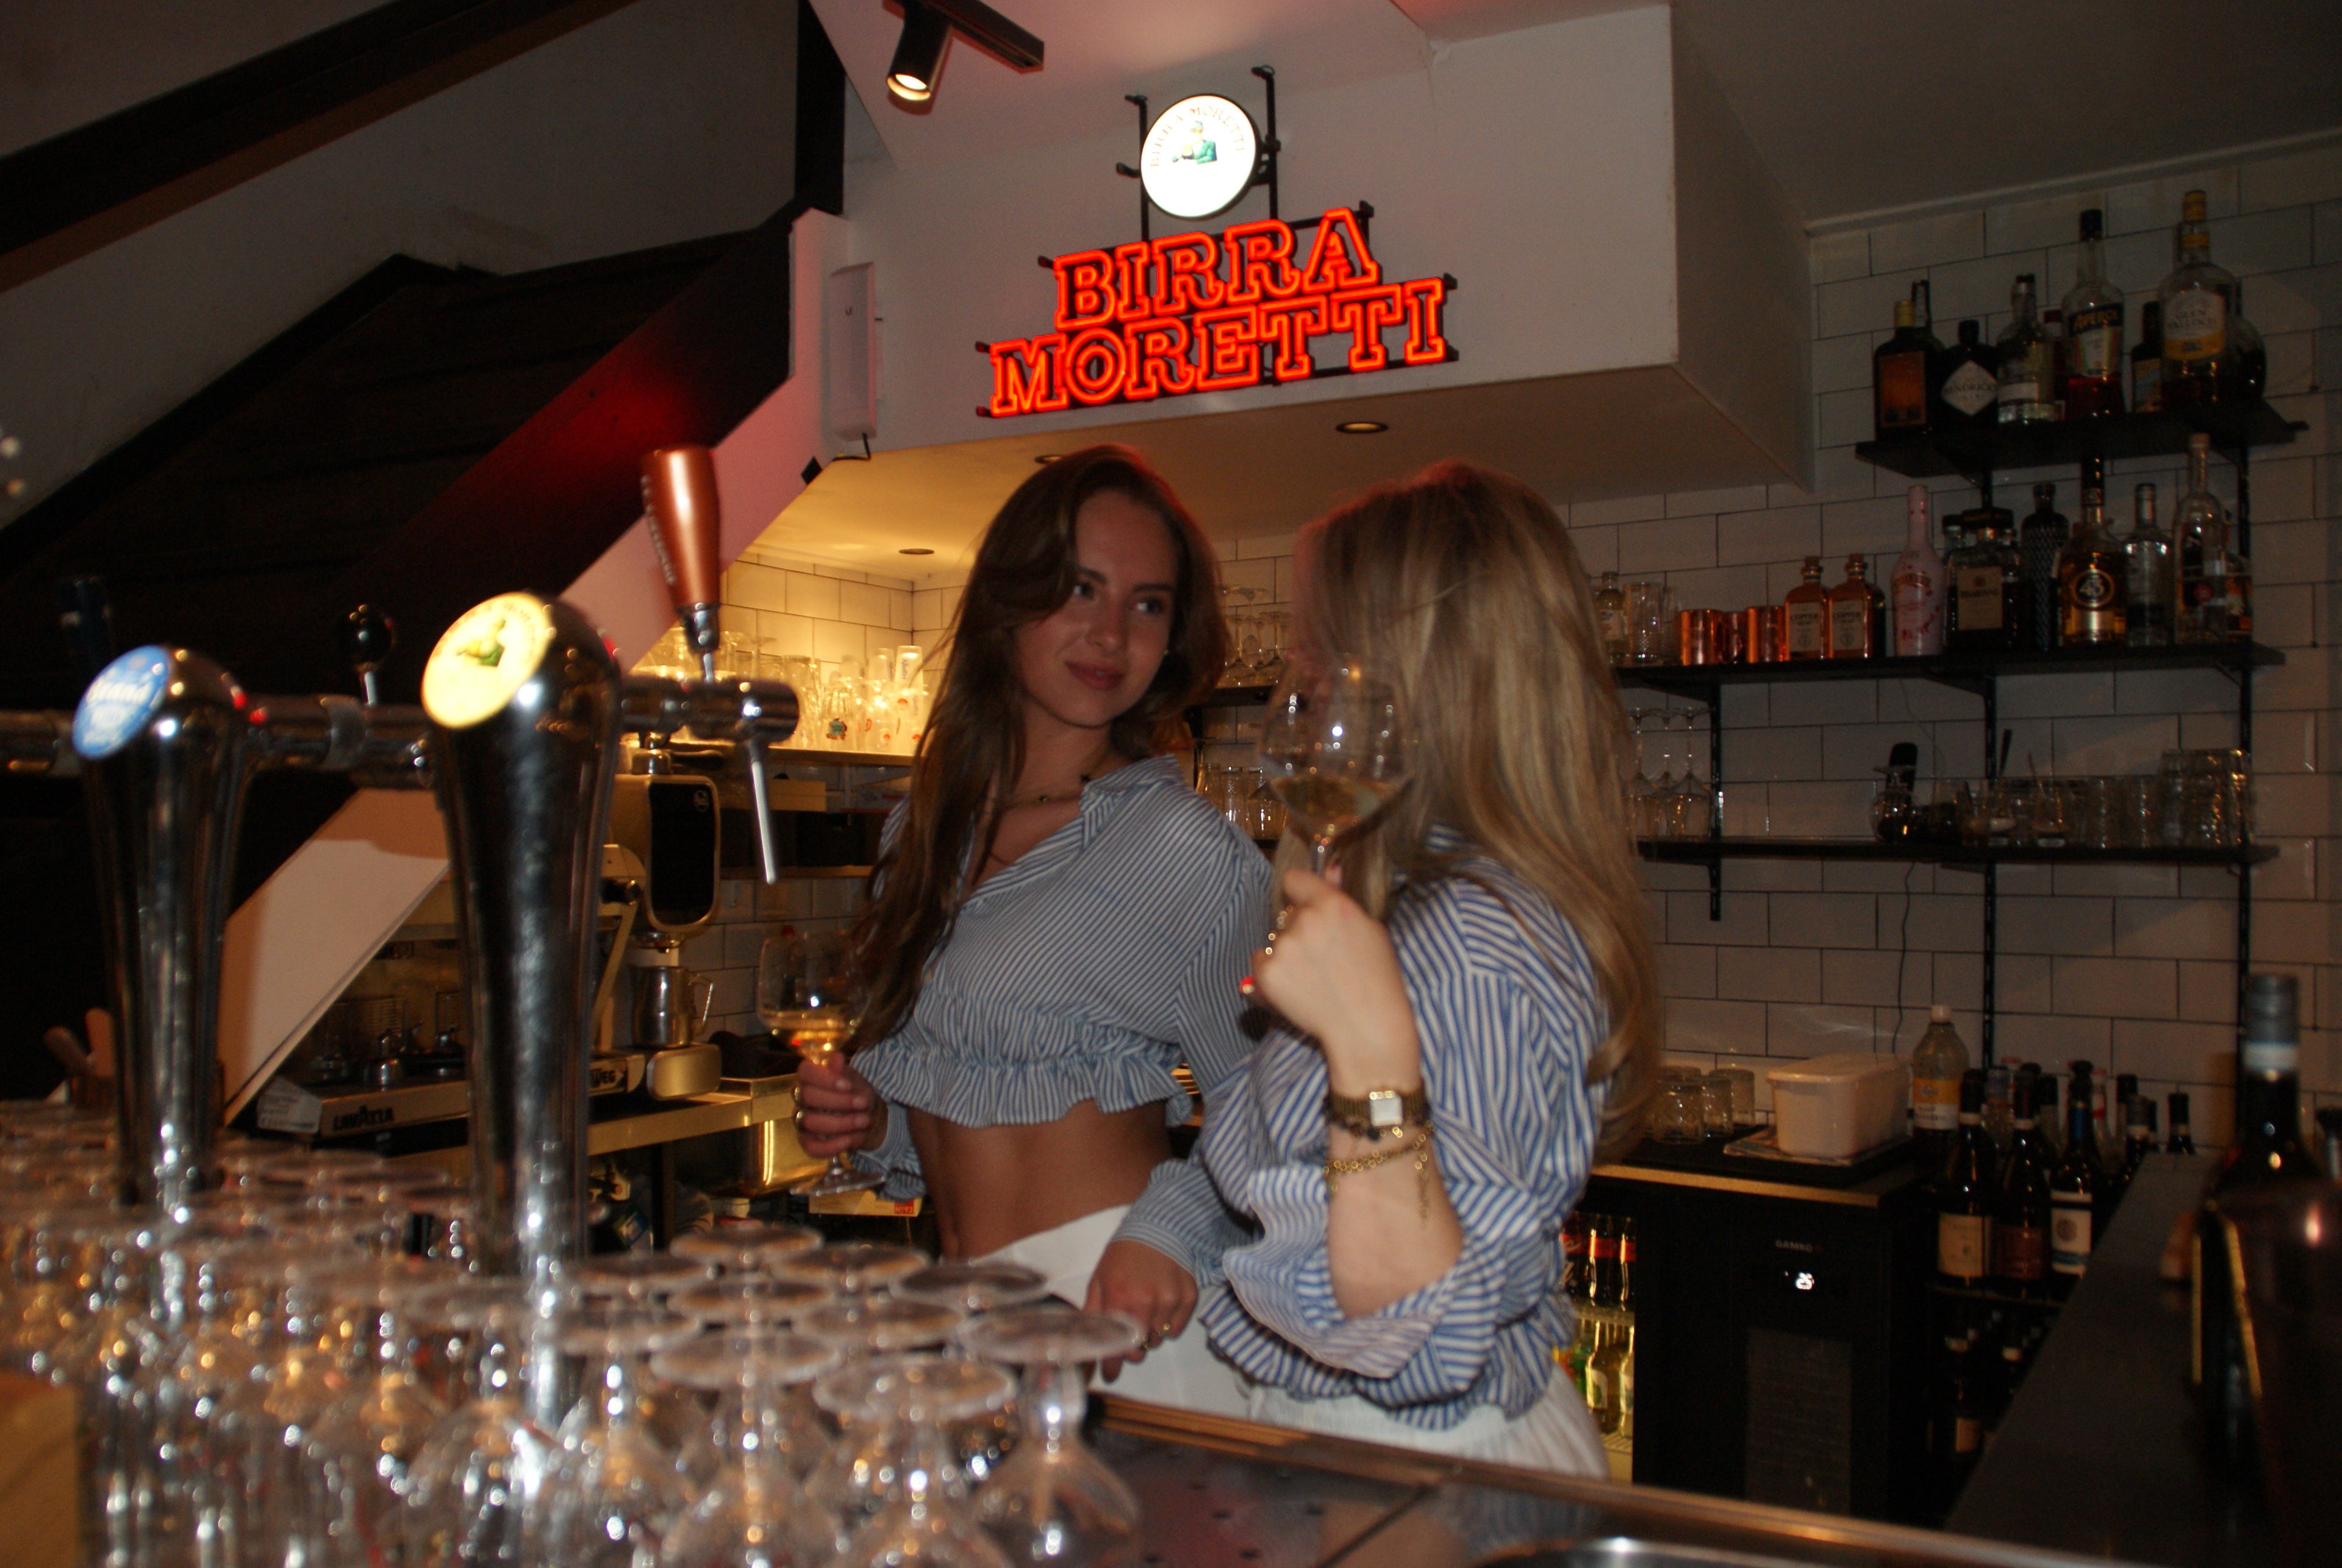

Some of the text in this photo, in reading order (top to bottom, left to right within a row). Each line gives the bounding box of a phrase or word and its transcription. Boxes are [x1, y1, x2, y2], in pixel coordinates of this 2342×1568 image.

[1189, 106, 1245, 152] MORETTI
[1054, 207, 1379, 330] BIRRA
[990, 277, 1446, 417] MORETTI
